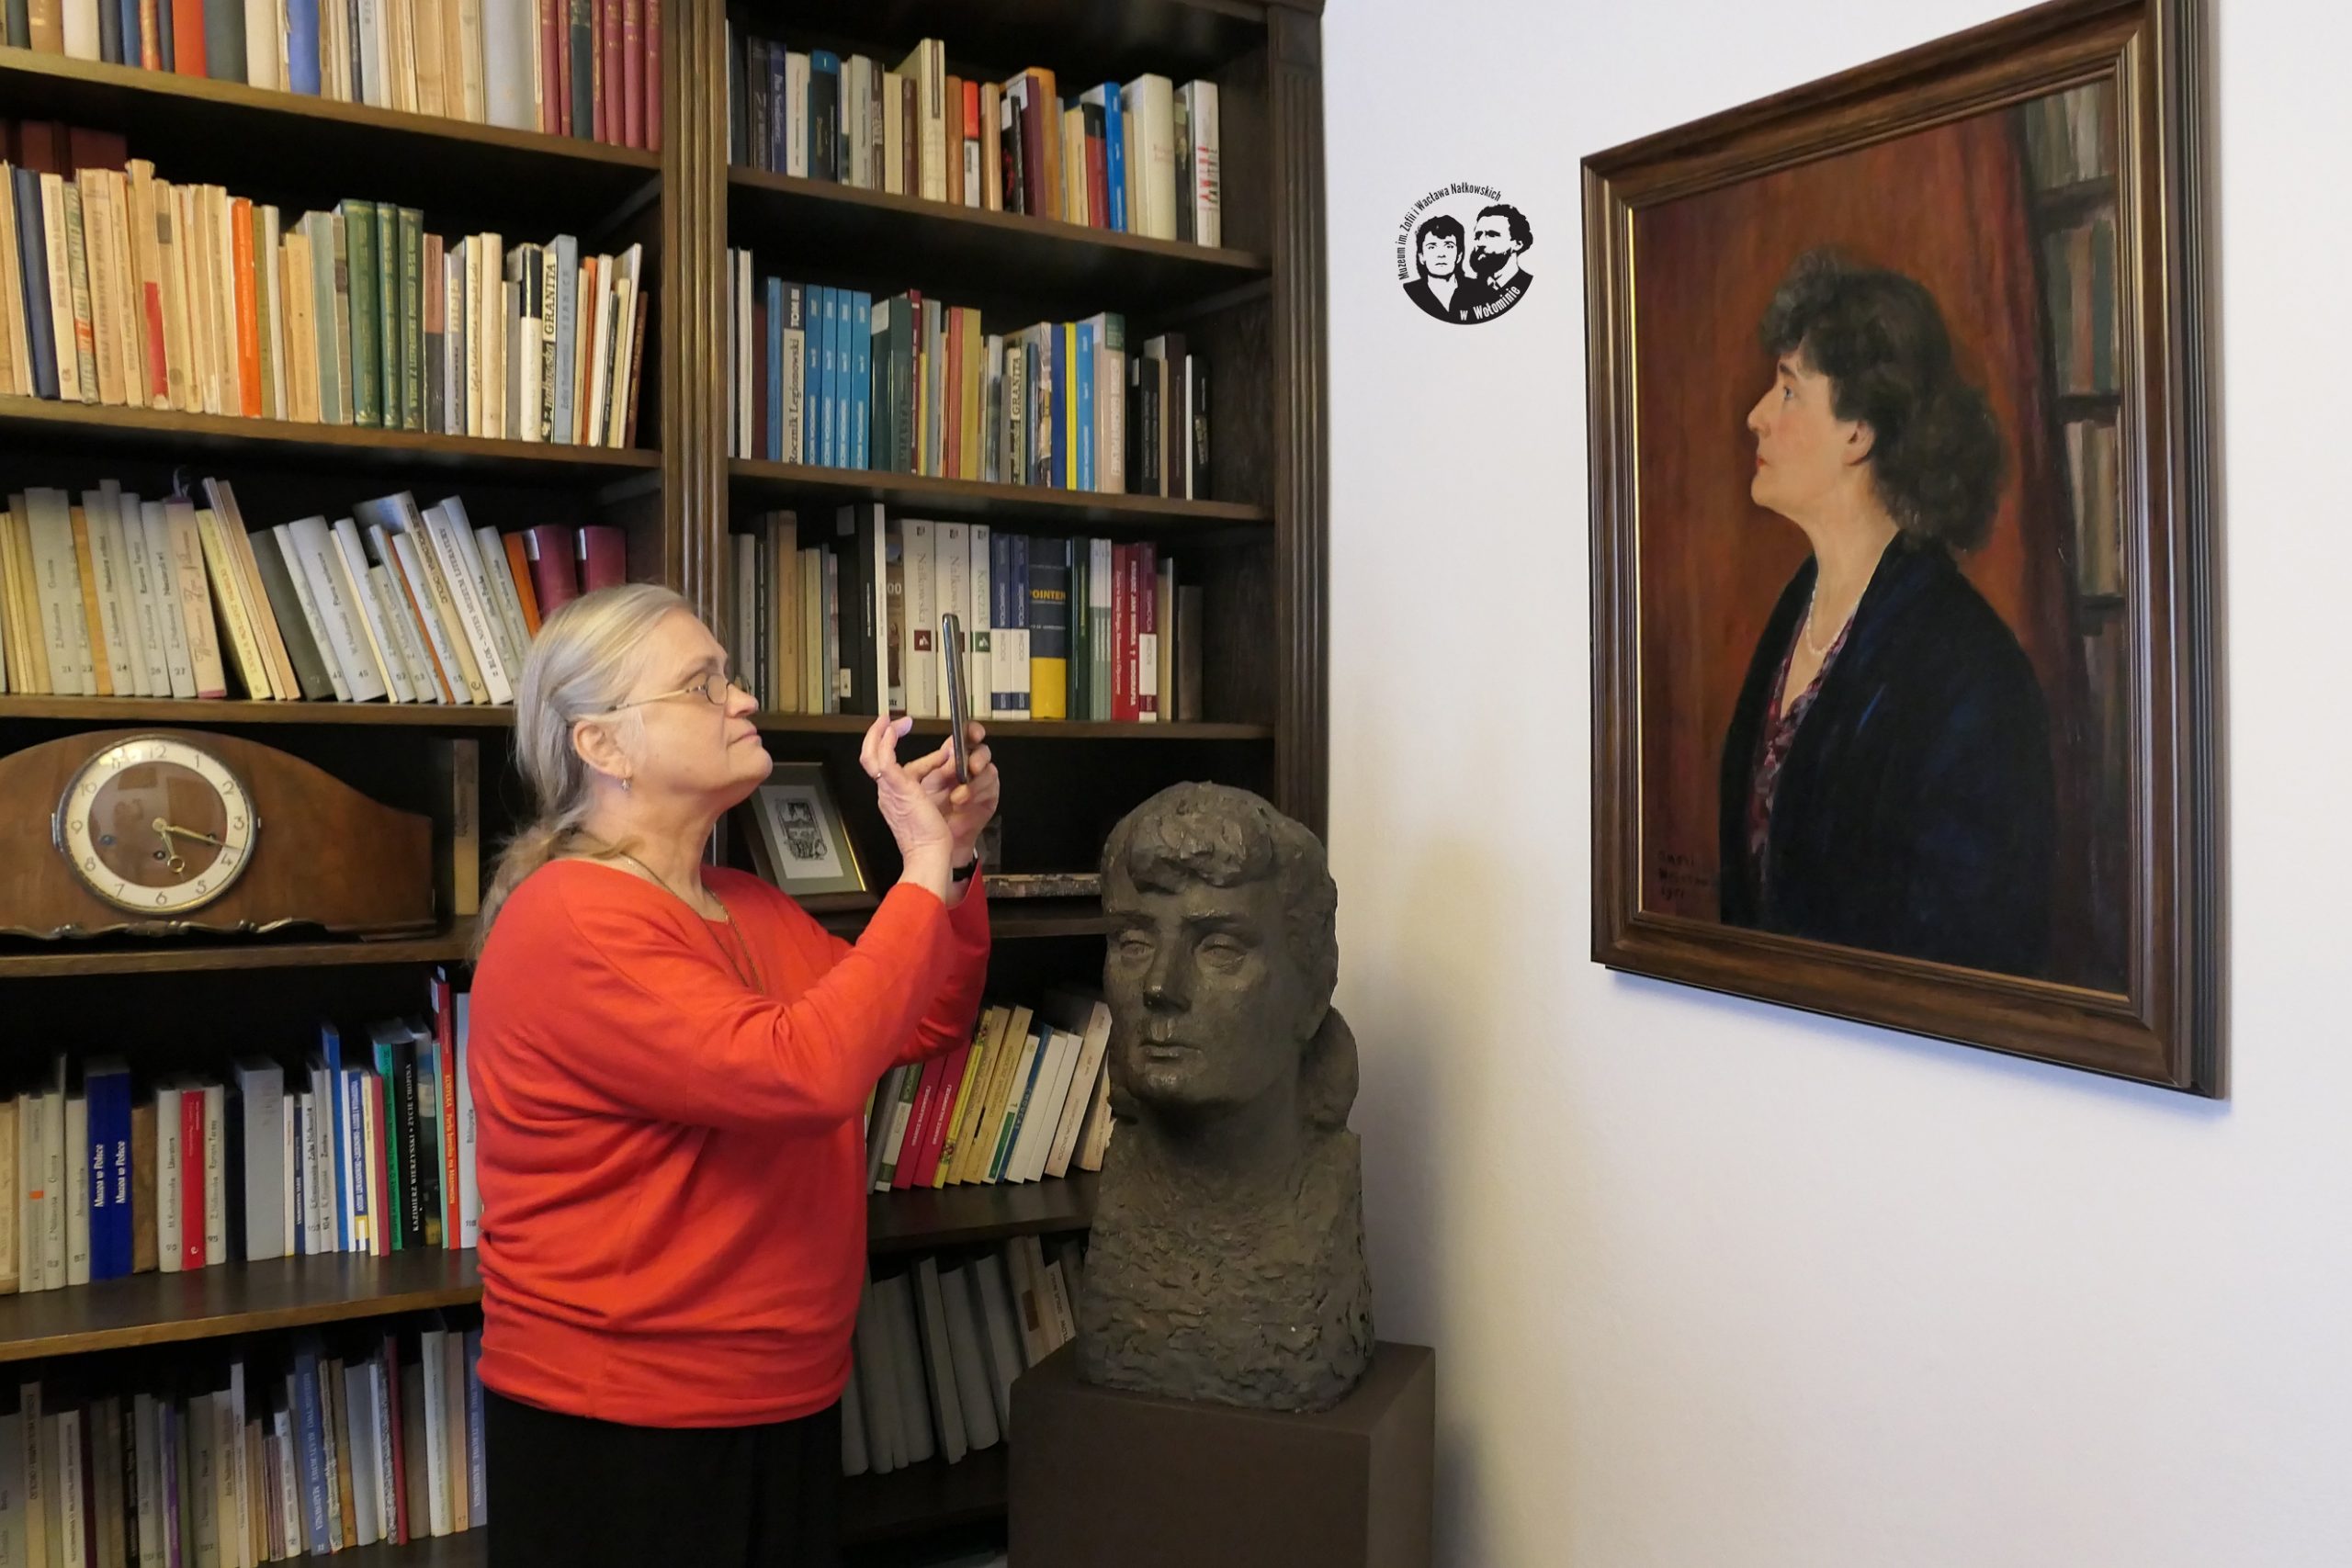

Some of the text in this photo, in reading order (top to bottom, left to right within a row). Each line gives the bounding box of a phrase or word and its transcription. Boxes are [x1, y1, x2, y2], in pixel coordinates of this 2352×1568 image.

[545, 262, 557, 335] GRANITA
[790, 301, 799, 327] TOM
[789, 337, 801, 412] Legionowski
[790, 416, 799, 462] Rocznik
[438, 527, 466, 579] LITERATURY
[950, 555, 962, 614] Nałkowsk
[149, 745, 166, 759] 12
[195, 755, 200, 768] 1
[81, 783, 97, 796] 10
[222, 781, 235, 795] 2
[73, 820, 83, 834] 9
[233, 816, 244, 831] 3
[85, 857, 96, 872] 8
[220, 853, 232, 866] 4
[114, 883, 125, 897] 7
[155, 892, 167, 905] 6
[196, 879, 207, 895] 5
[445, 1074, 453, 1108] KOBYŁKA
[93, 1144, 104, 1169] Polsce
[115, 1140, 126, 1167] Polsce
[404, 1063, 419, 1232] KAZIMIERZ WIERZYŃSKI ŻYCIE CHOPINA
[93, 1181, 105, 1207] Muzea
[116, 1178, 127, 1204] Muzea
[447, 1168, 456, 1204] Mazowszu
